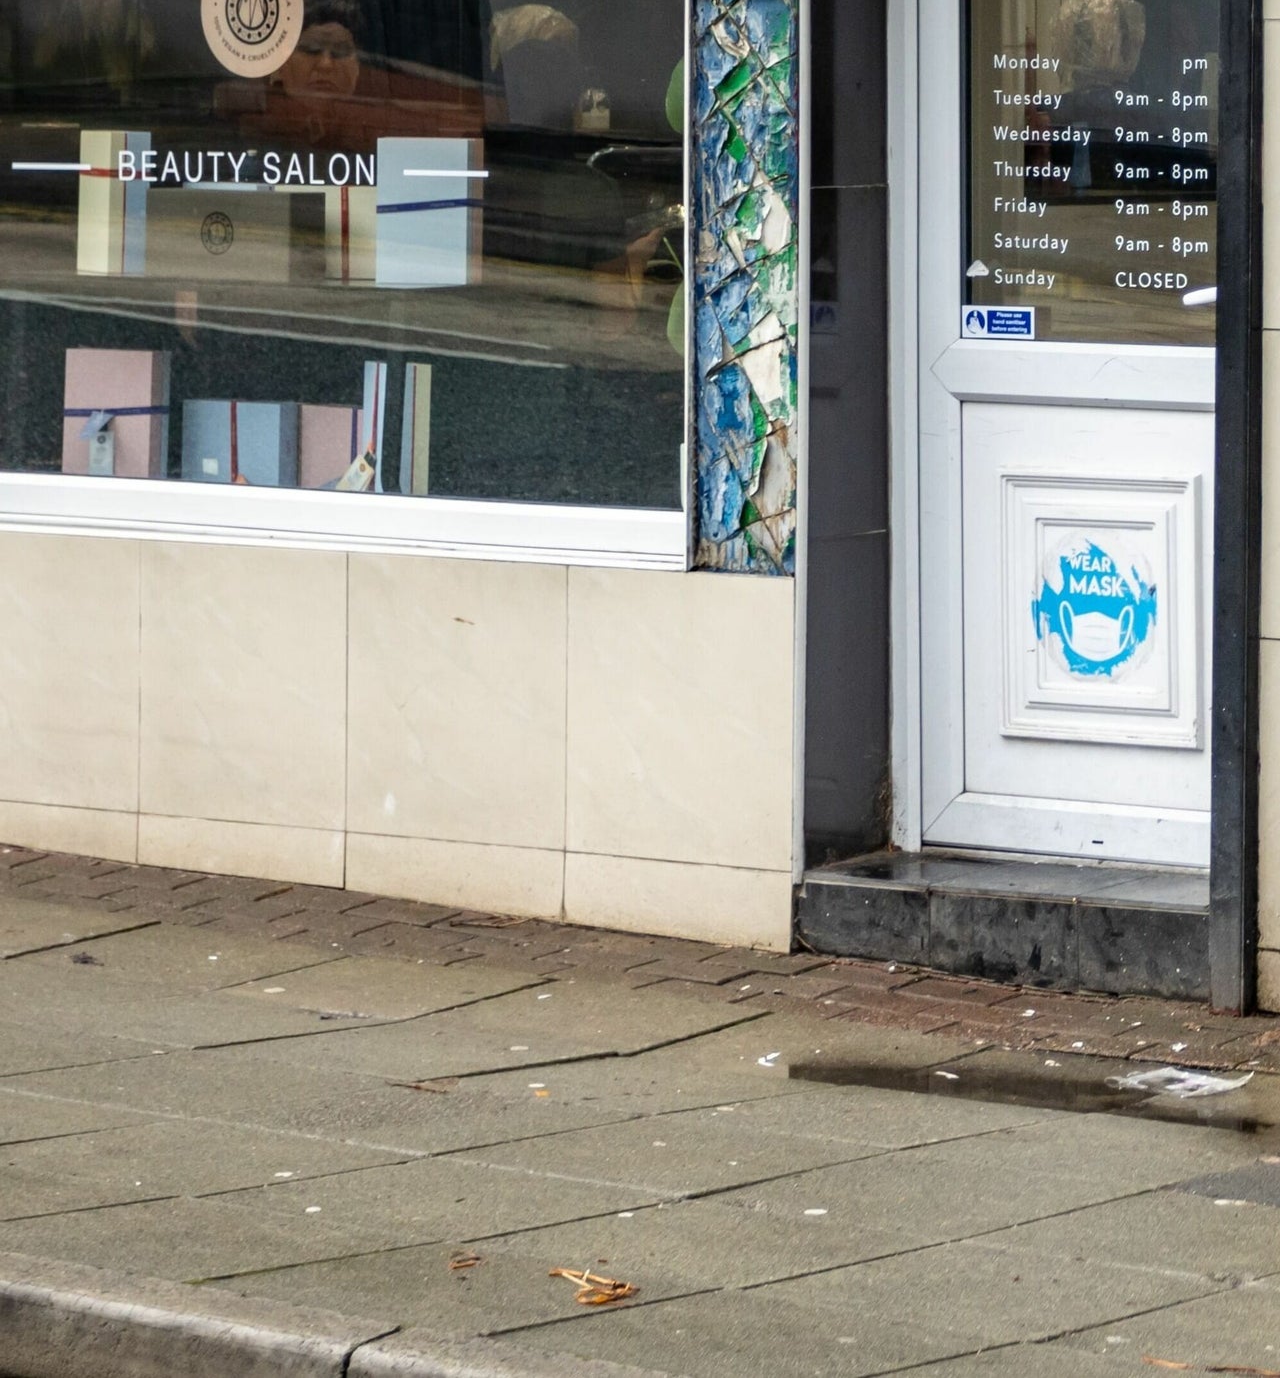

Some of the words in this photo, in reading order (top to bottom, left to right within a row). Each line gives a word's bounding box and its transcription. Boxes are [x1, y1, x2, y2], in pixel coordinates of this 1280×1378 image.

[994, 54, 1060, 73] Monday
[1183, 58, 1208, 75] pm
[993, 90, 1062, 110] Tuesday
[1115, 90, 1149, 106] 9am
[1172, 91, 1208, 111] 8pm
[993, 126, 1091, 146] Wednesday
[1115, 127, 1149, 142] 9am
[1172, 127, 1208, 147] 8pm
[118, 150, 246, 183] BEAUTY
[263, 152, 374, 185] SALON
[993, 162, 1071, 182] Thursday
[1115, 163, 1149, 178] 9am
[1172, 163, 1208, 184] 8pm
[994, 198, 1047, 218] Friday
[1115, 199, 1150, 215] 9am
[1172, 200, 1208, 221] 8pm
[994, 233, 1069, 254] Saturday
[1115, 235, 1150, 251] 9am
[1172, 236, 1208, 257] 8pm
[994, 269, 1055, 290] Sunday
[1115, 272, 1188, 289] CLOSED
[1068, 556, 1112, 573] WEAR
[1070, 574, 1126, 598] MASK
